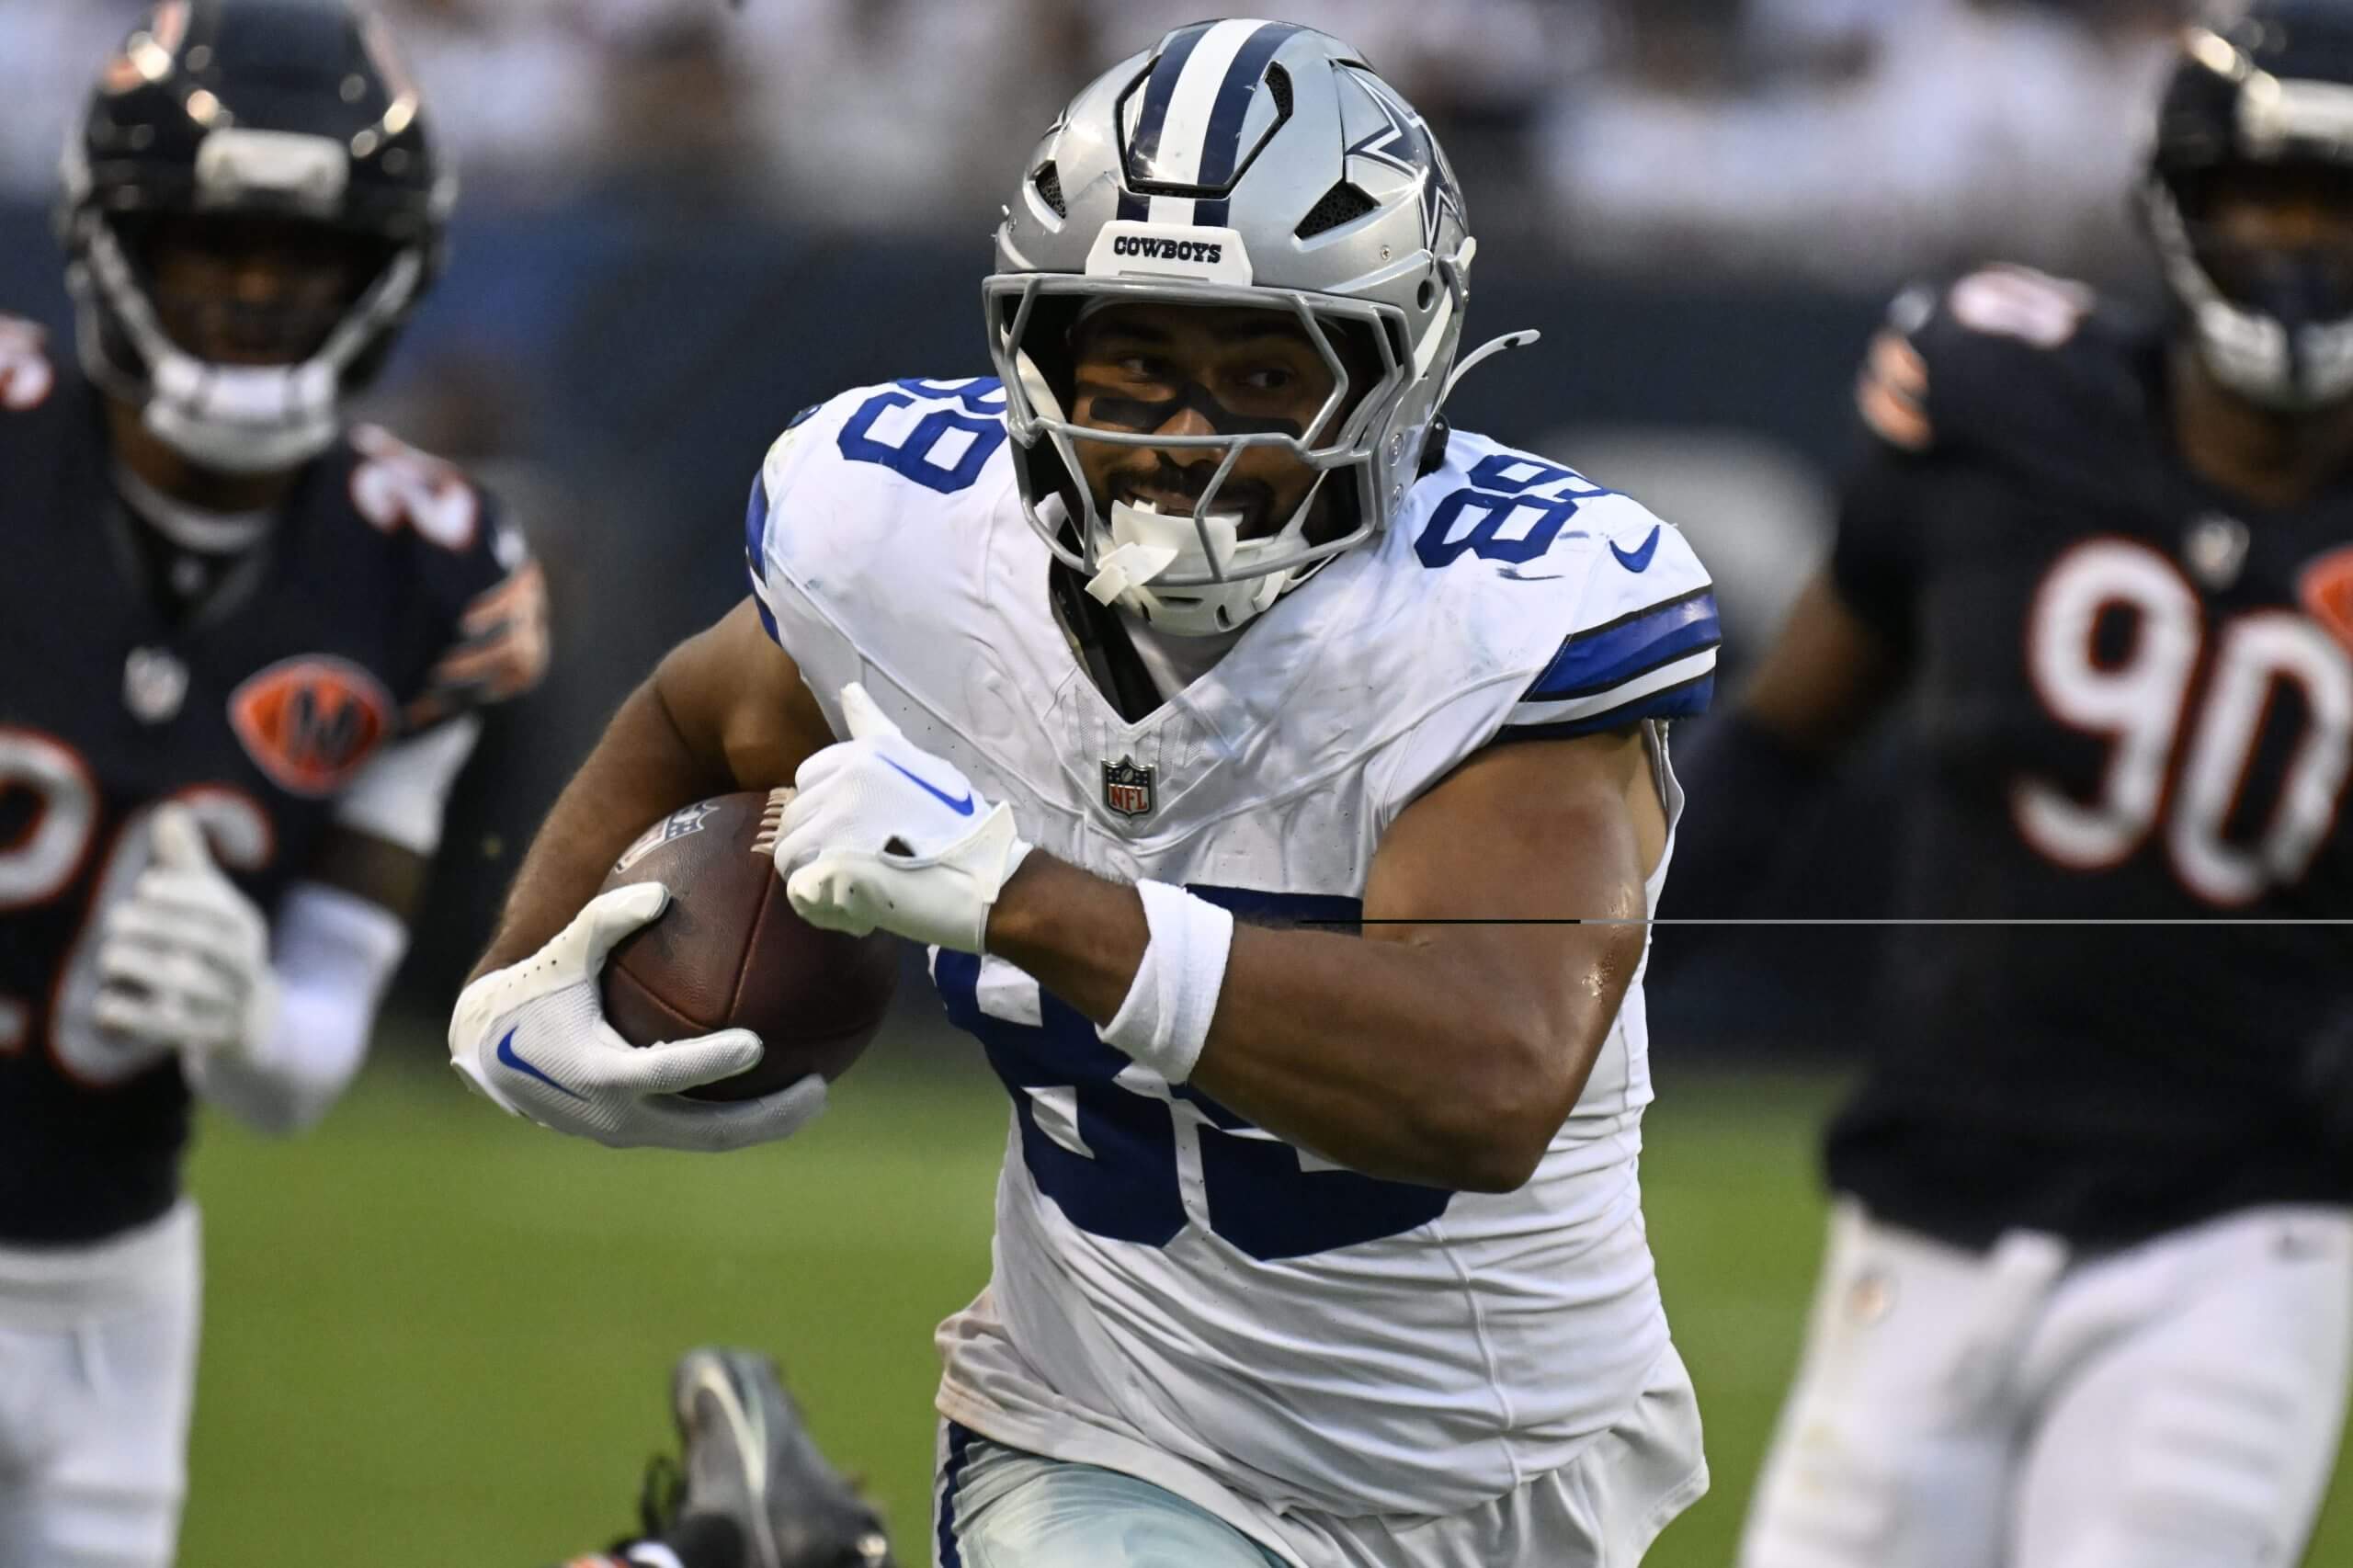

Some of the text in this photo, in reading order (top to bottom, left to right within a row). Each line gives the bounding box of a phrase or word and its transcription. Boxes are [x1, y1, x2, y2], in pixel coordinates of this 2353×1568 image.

[1113, 235, 1222, 264] COWBOYS
[1414, 454, 1630, 568] 89
[2013, 536, 2353, 907] 90
[1108, 785, 1149, 812] NFL
